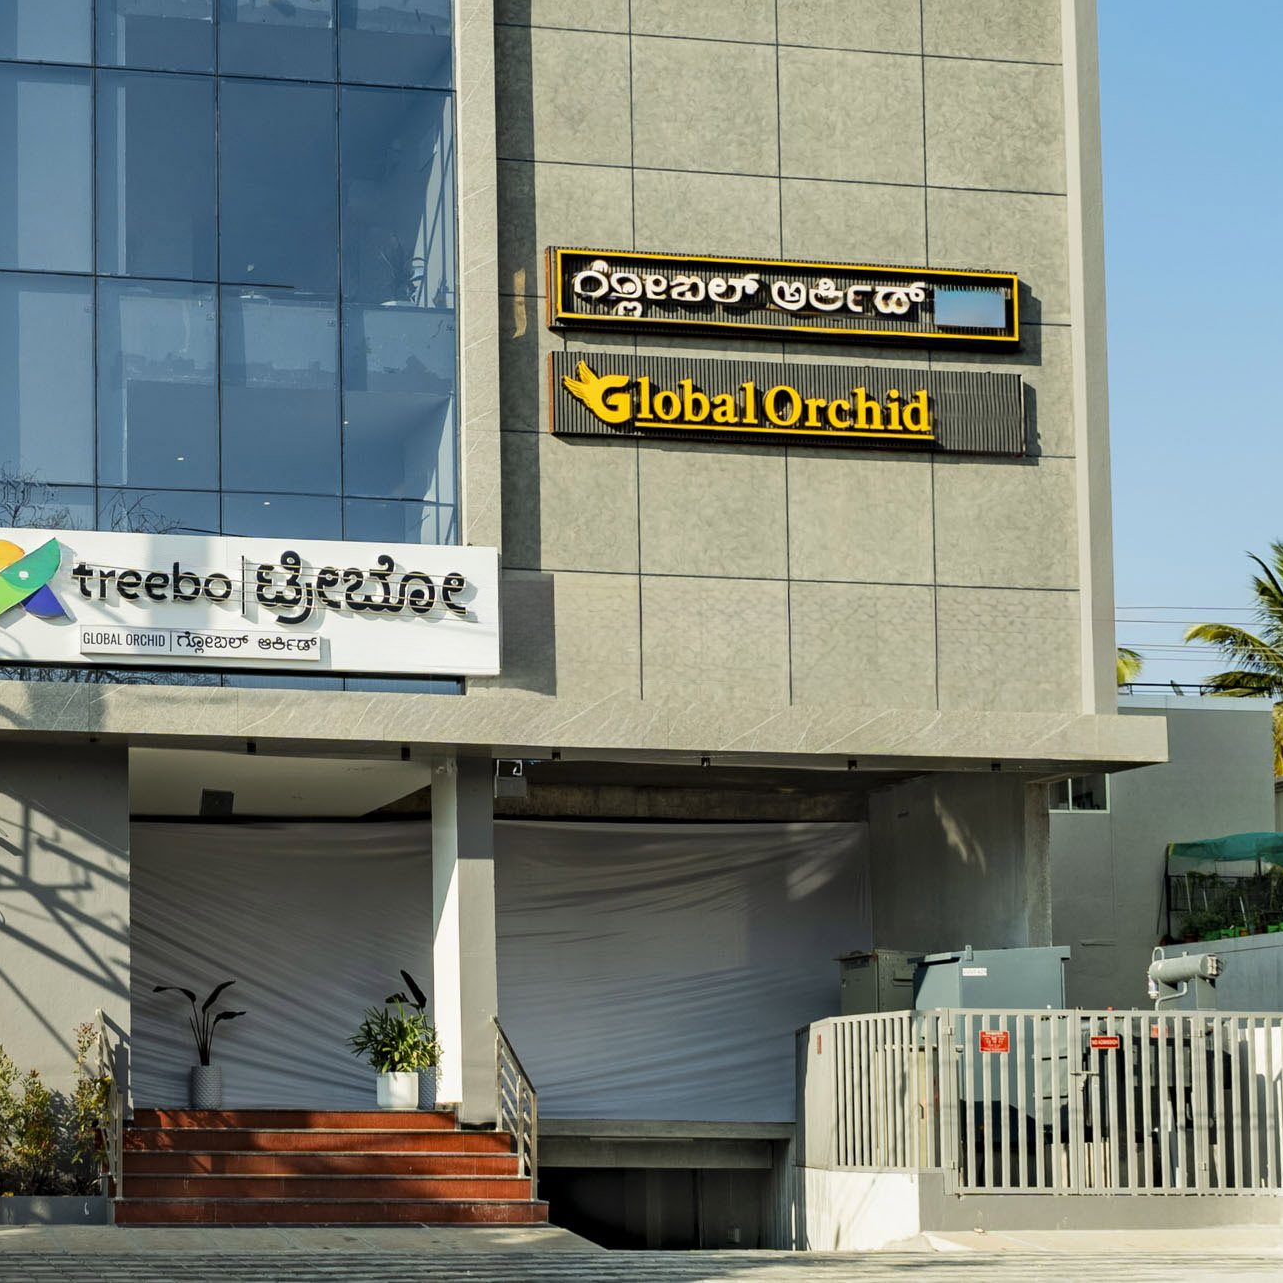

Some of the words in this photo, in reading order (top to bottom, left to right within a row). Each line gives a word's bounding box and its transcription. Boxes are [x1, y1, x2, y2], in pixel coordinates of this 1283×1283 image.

[574, 259, 760, 318] ಗ್ಲೋಬಲ್
[771, 277, 926, 315] ಆರ್ಕಿಡ್
[564, 359, 758, 424] Global
[767, 385, 932, 432] Orchid
[72, 562, 233, 604] treebo
[83, 632, 122, 646] GLOBAL
[126, 634, 165, 647] ORCHID
[176, 631, 249, 654] ಗ್ಲೋಬಲ್
[258, 636, 317, 652] ಆರ್ಕಿಡ್
